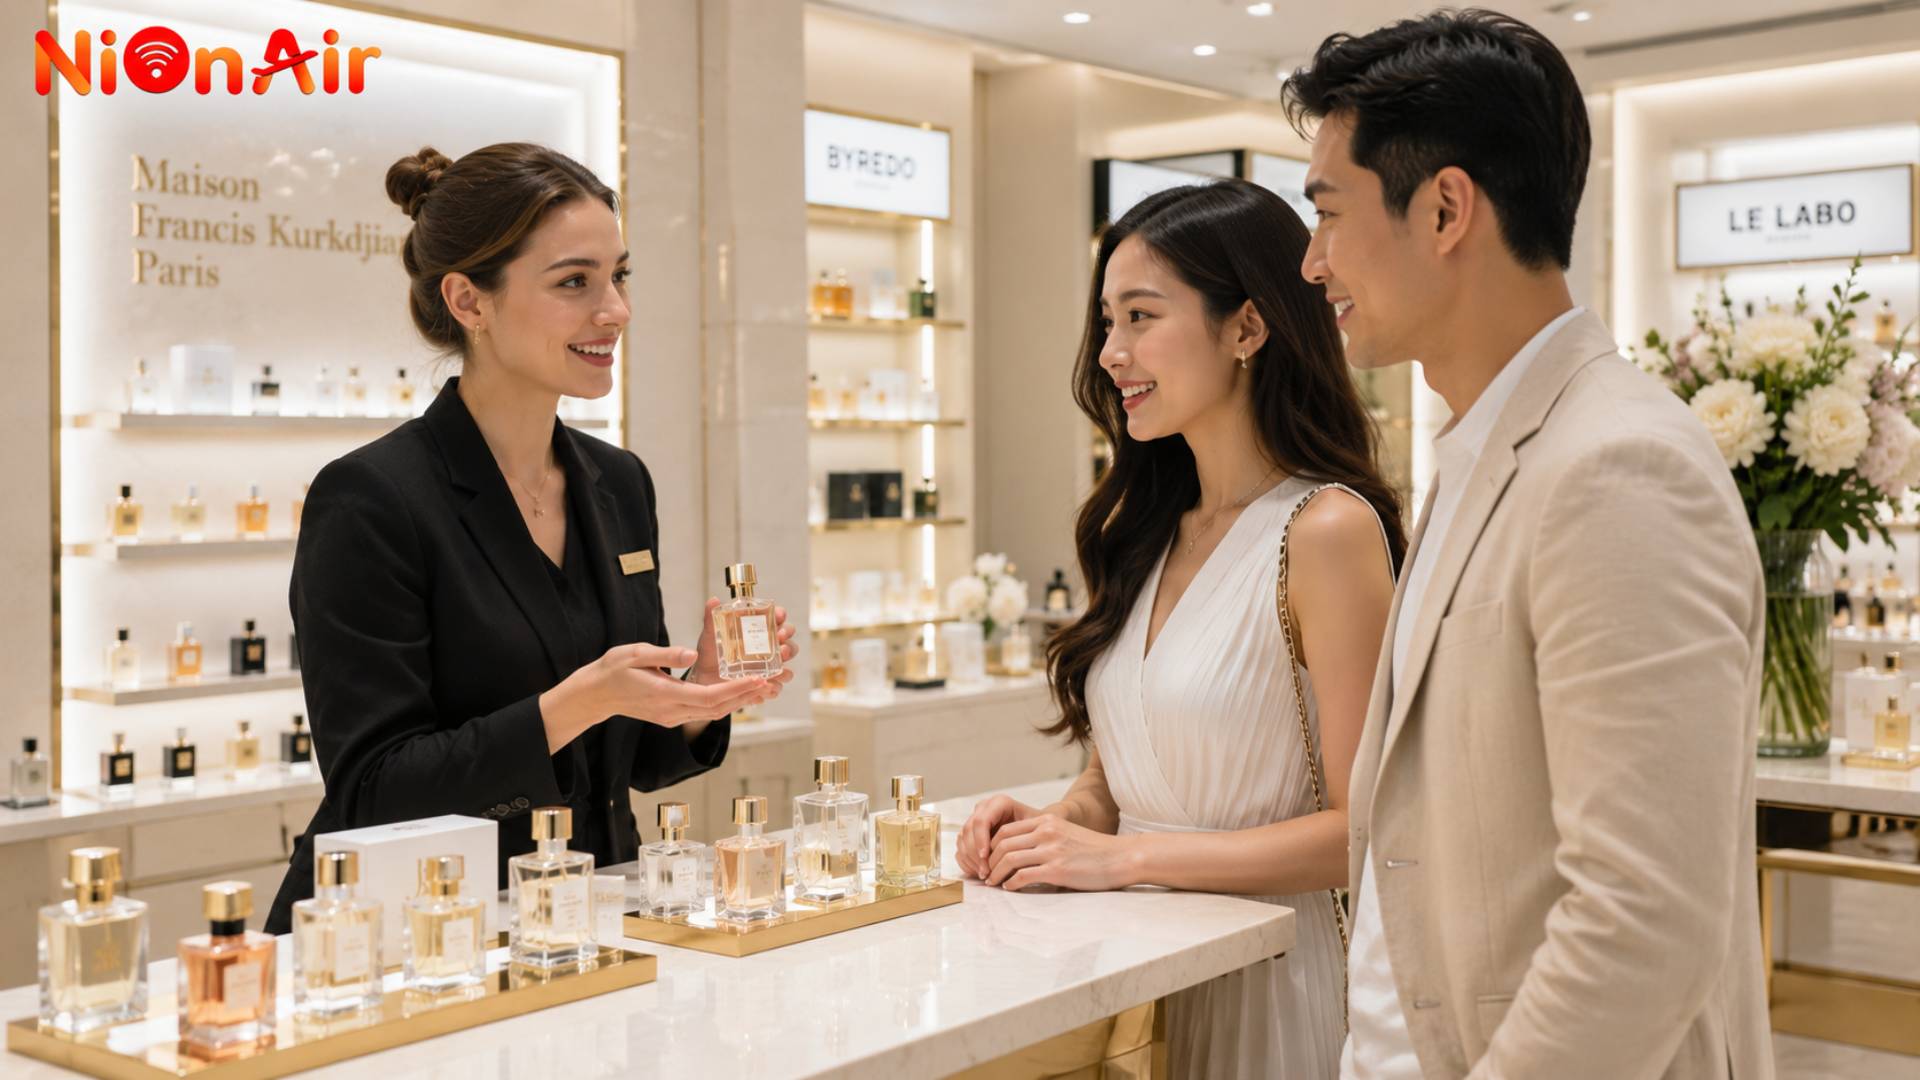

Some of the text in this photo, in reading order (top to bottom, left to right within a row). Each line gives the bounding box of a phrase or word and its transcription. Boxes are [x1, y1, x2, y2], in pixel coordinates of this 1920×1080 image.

[132, 154, 260, 201] Maison
[827, 144, 916, 180] BYREDO
[132, 202, 256, 246] Francis
[1729, 200, 1856, 232] LE LABO
[132, 249, 220, 288] Paris
